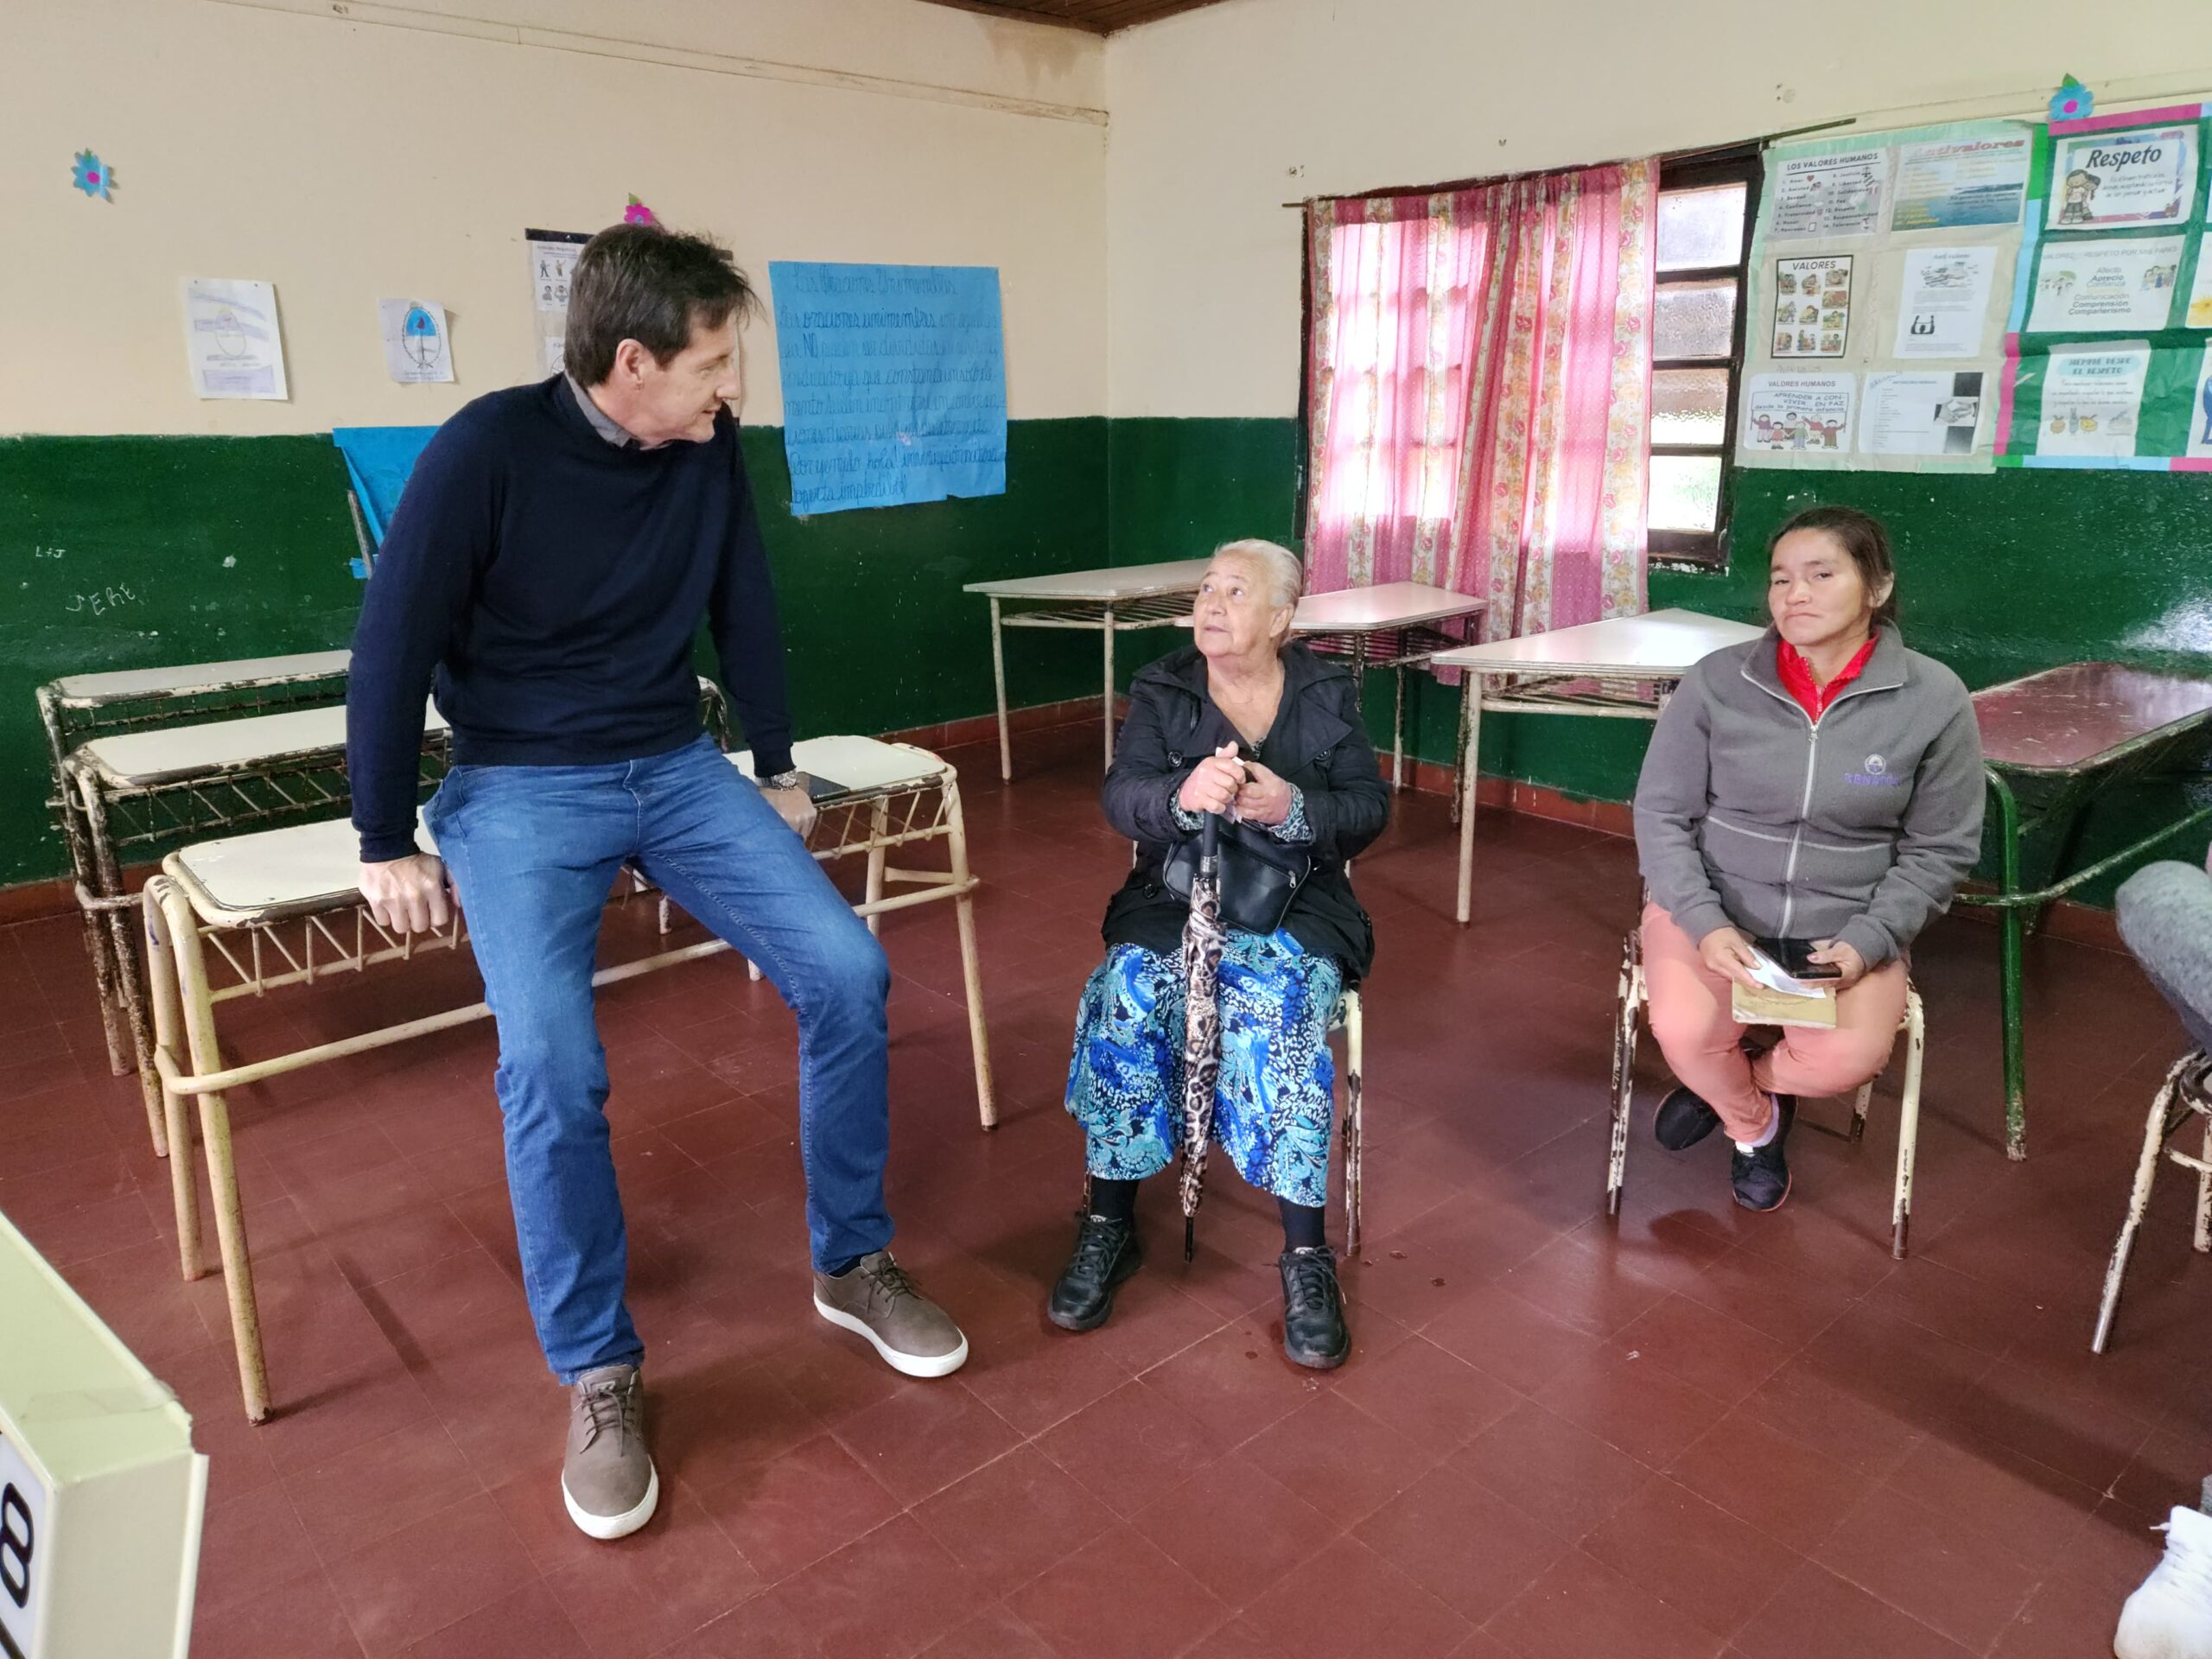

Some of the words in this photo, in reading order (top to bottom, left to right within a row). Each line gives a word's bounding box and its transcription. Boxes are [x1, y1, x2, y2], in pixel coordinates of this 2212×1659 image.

[1803, 157, 1838, 168] VALORES
[1840, 152, 1878, 164] HUMANOS
[2086, 144, 2162, 172] Respeto
[1792, 260, 1837, 270] VALORES
[2090, 275, 2124, 283] Aprecio
[2072, 301, 2129, 309] Comprensión
[862, 305, 937, 329] unimembres
[803, 332, 818, 359] NO
[2087, 366, 2122, 375] RESPETO
[1774, 392, 1813, 401] APRENDER
[0, 1482, 35, 1610] 8
